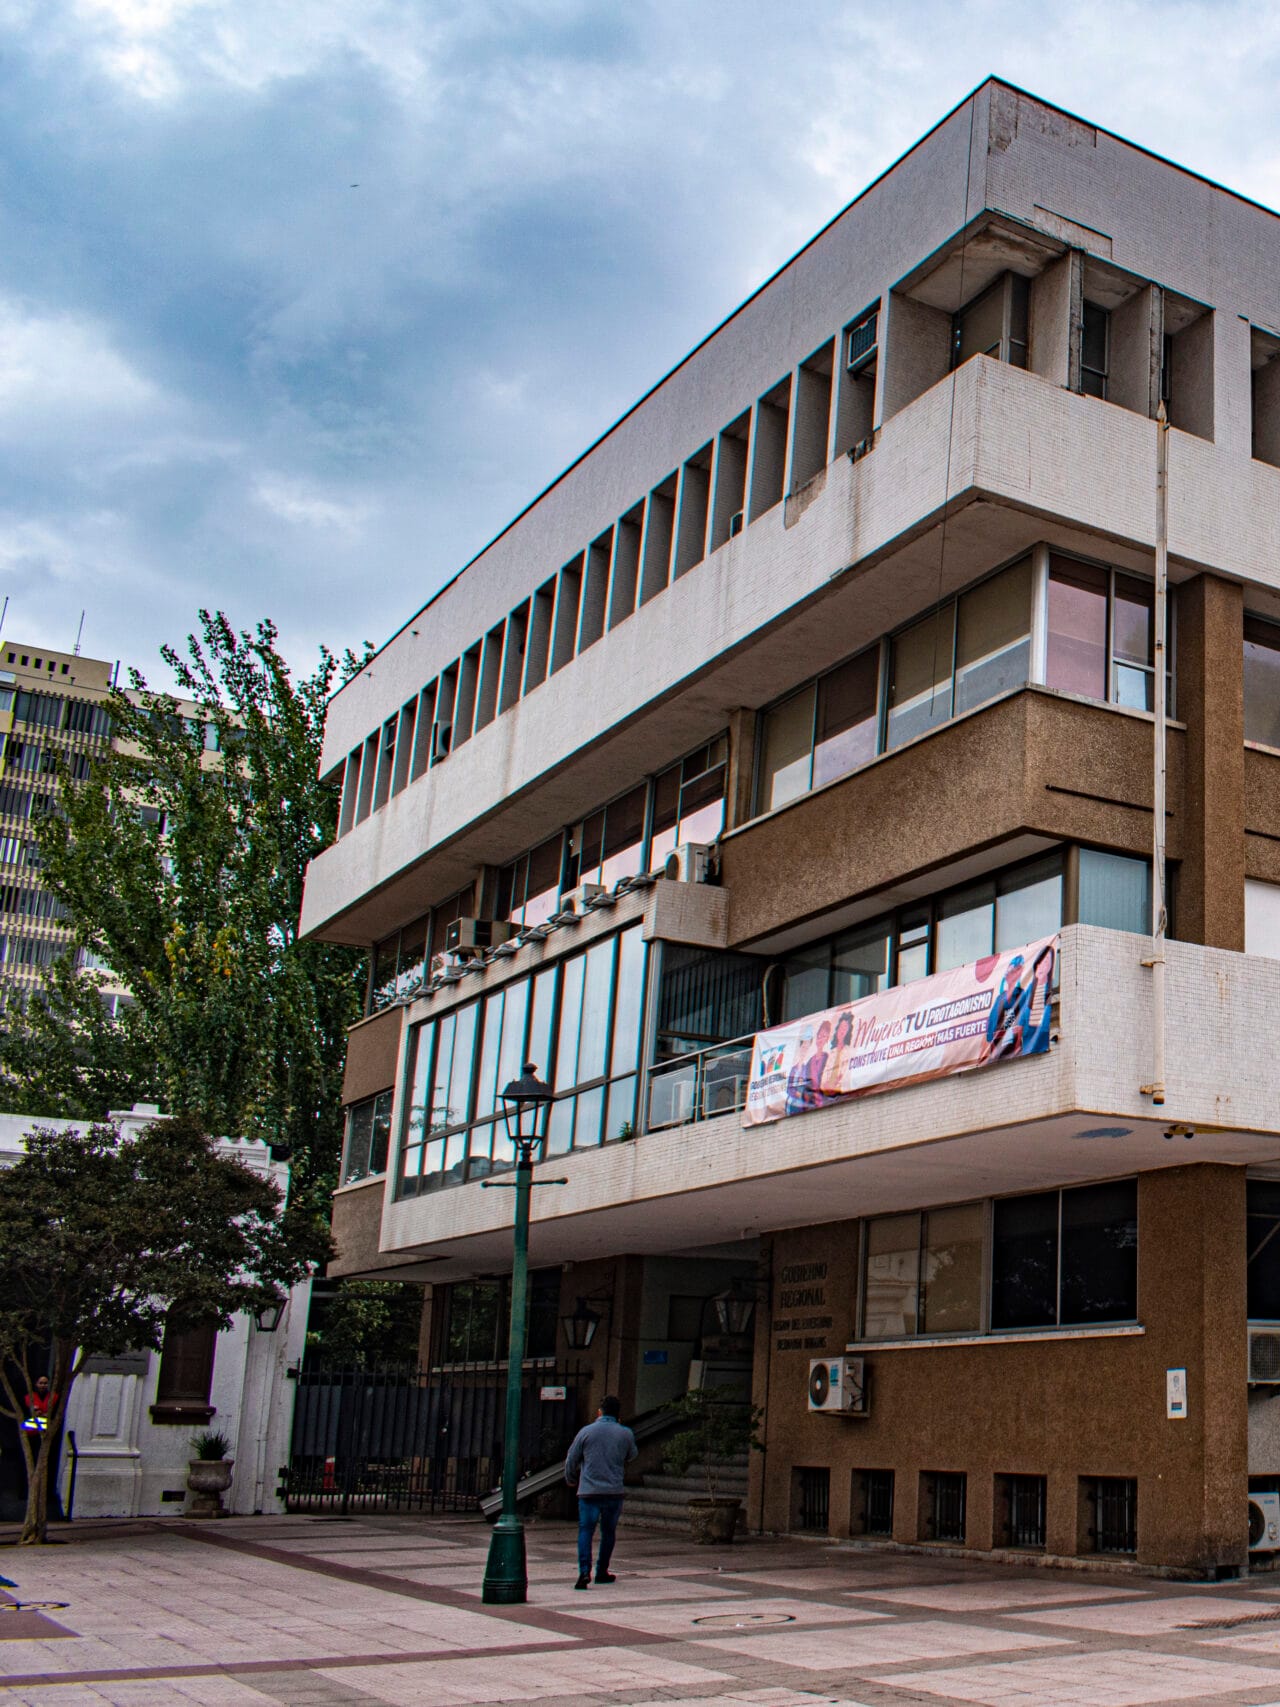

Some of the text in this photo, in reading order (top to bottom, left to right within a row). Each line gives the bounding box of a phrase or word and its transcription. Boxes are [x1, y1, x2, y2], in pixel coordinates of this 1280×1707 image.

[853, 992, 993, 1053] Mujeres TU PROTAGONISMO
[849, 1048, 888, 1070] CONSTRUYE
[889, 1044, 904, 1058] UNA
[905, 1036, 934, 1053] REGIÓN
[955, 1022, 987, 1039] FUERTE
[781, 1263, 828, 1283] GOBIERNO
[780, 1288, 826, 1308] REGIONAL
